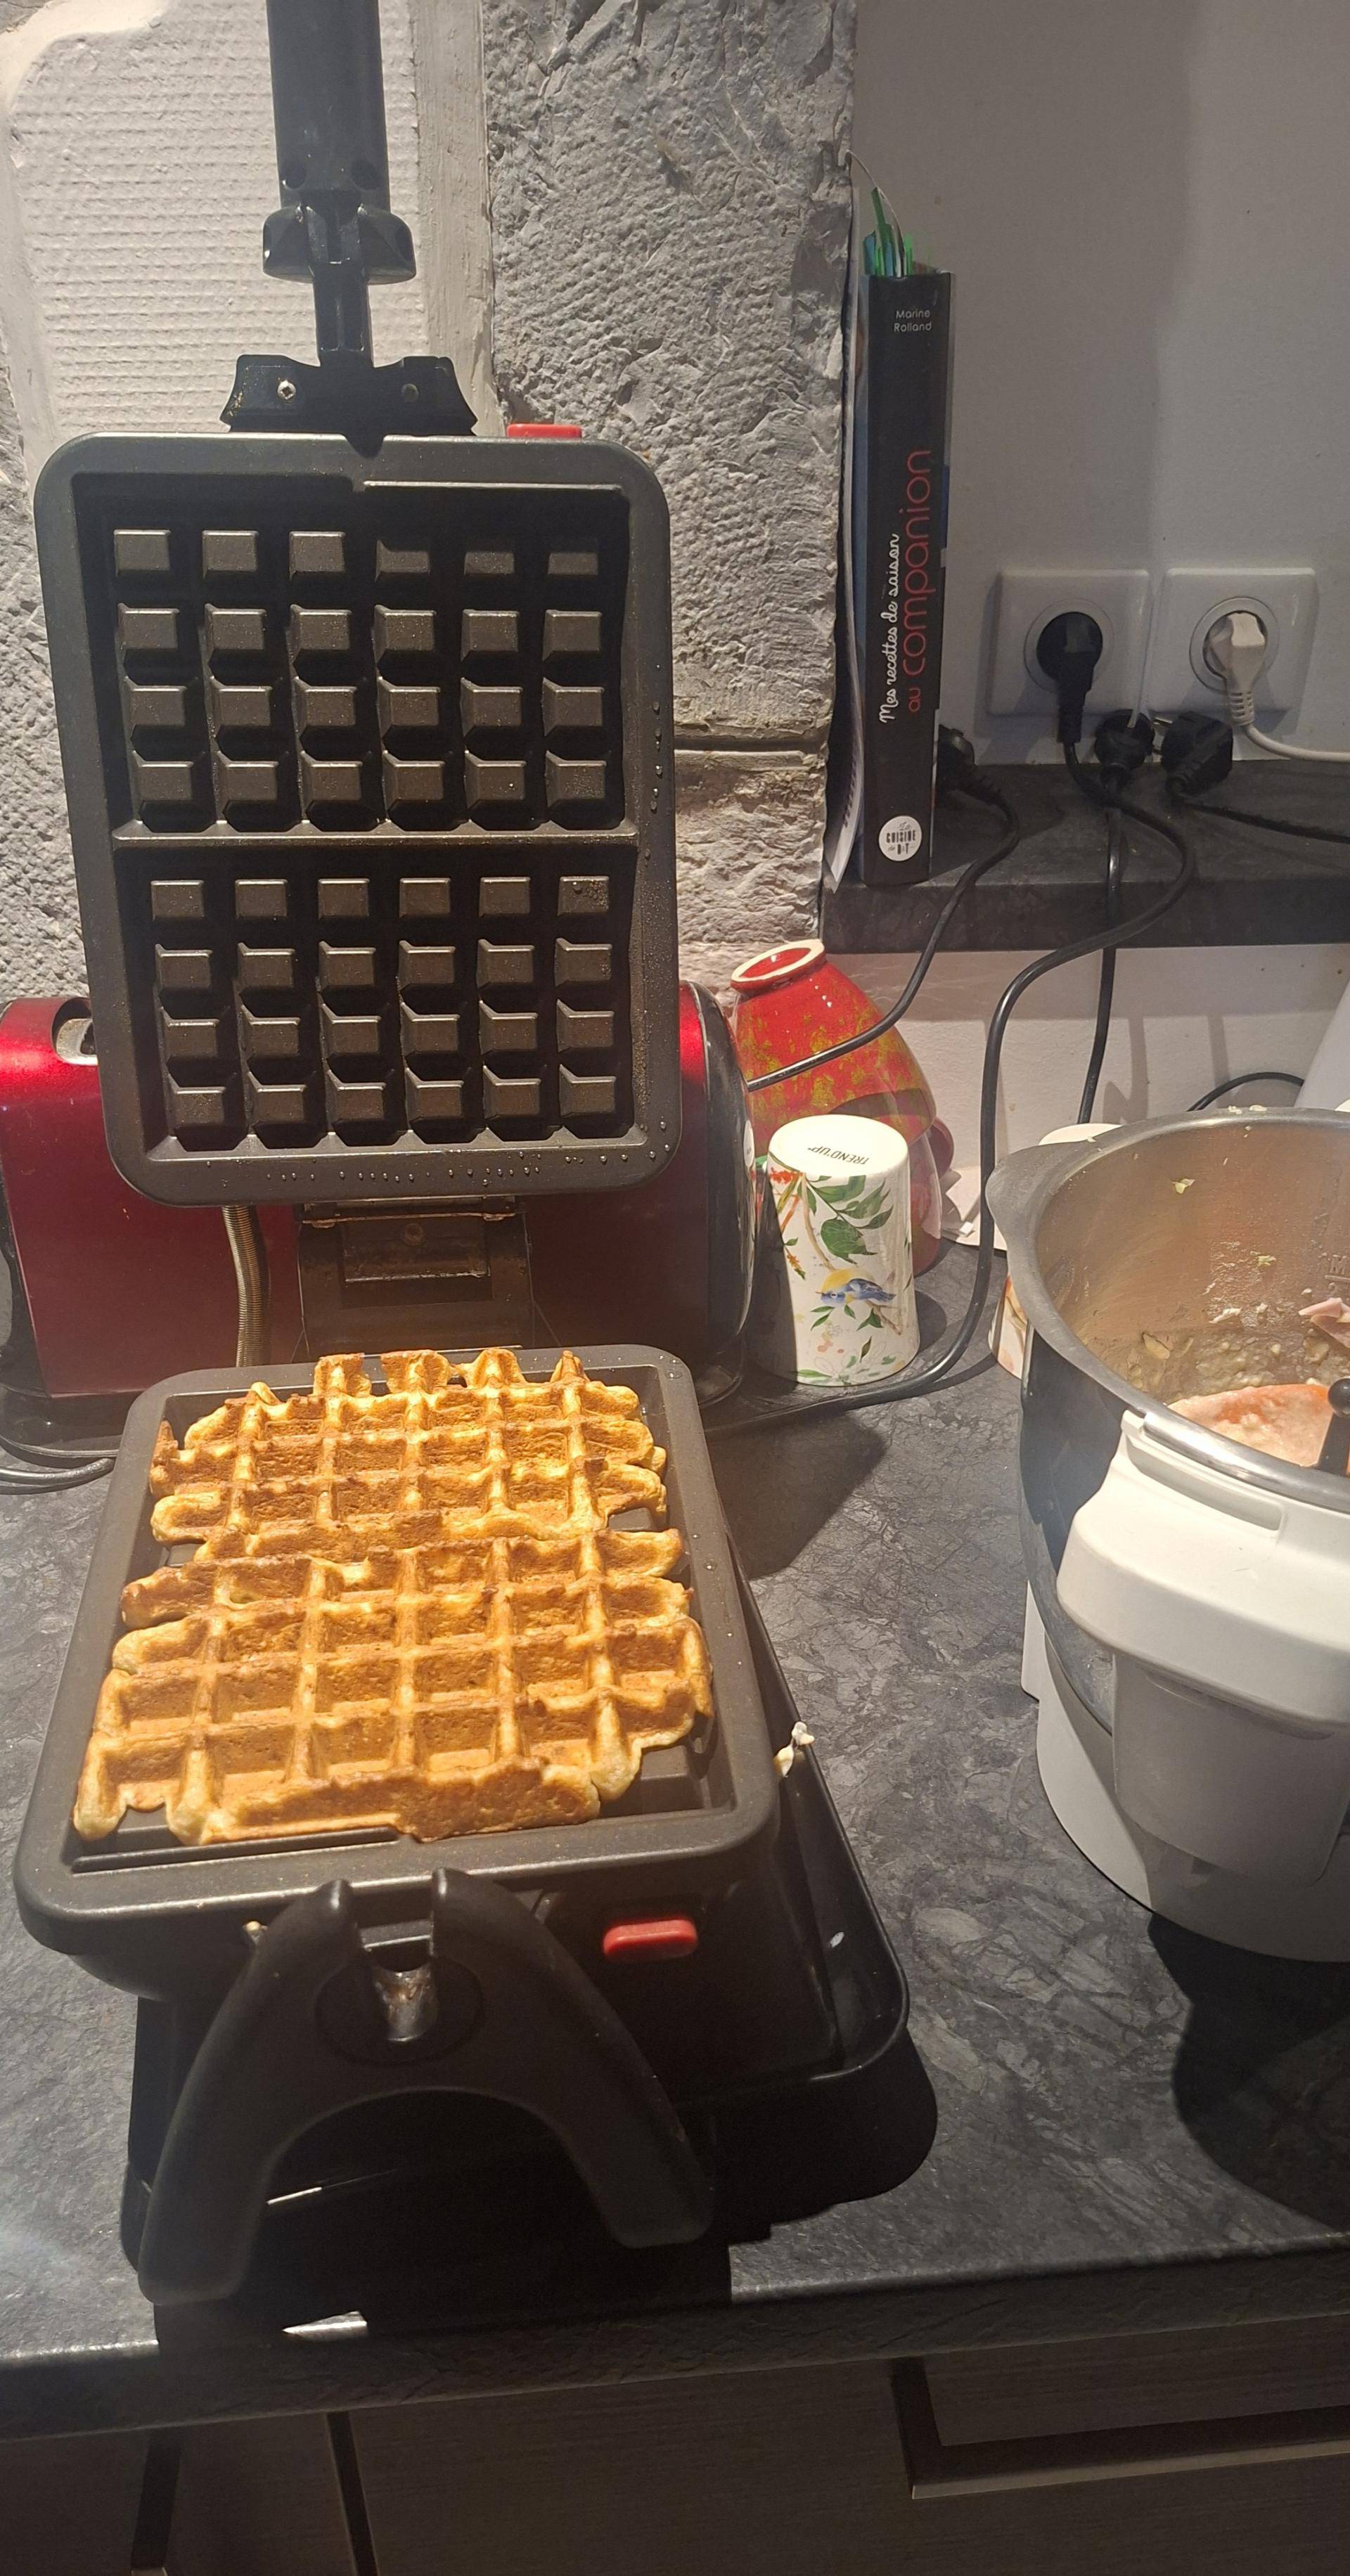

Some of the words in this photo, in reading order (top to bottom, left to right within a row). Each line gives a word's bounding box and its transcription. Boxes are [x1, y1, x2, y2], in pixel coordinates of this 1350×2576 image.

[895, 309, 931, 320] Marine
[893, 321, 932, 333] Rolland
[886, 533, 900, 598] saison
[899, 450, 937, 676] companion
[880, 600, 899, 624] de
[881, 626, 899, 685] recettes
[878, 688, 899, 723] Mes
[908, 687, 921, 712] au
[885, 830, 916, 844] CUISINE
[808, 1146, 870, 1165] TREND'UP
